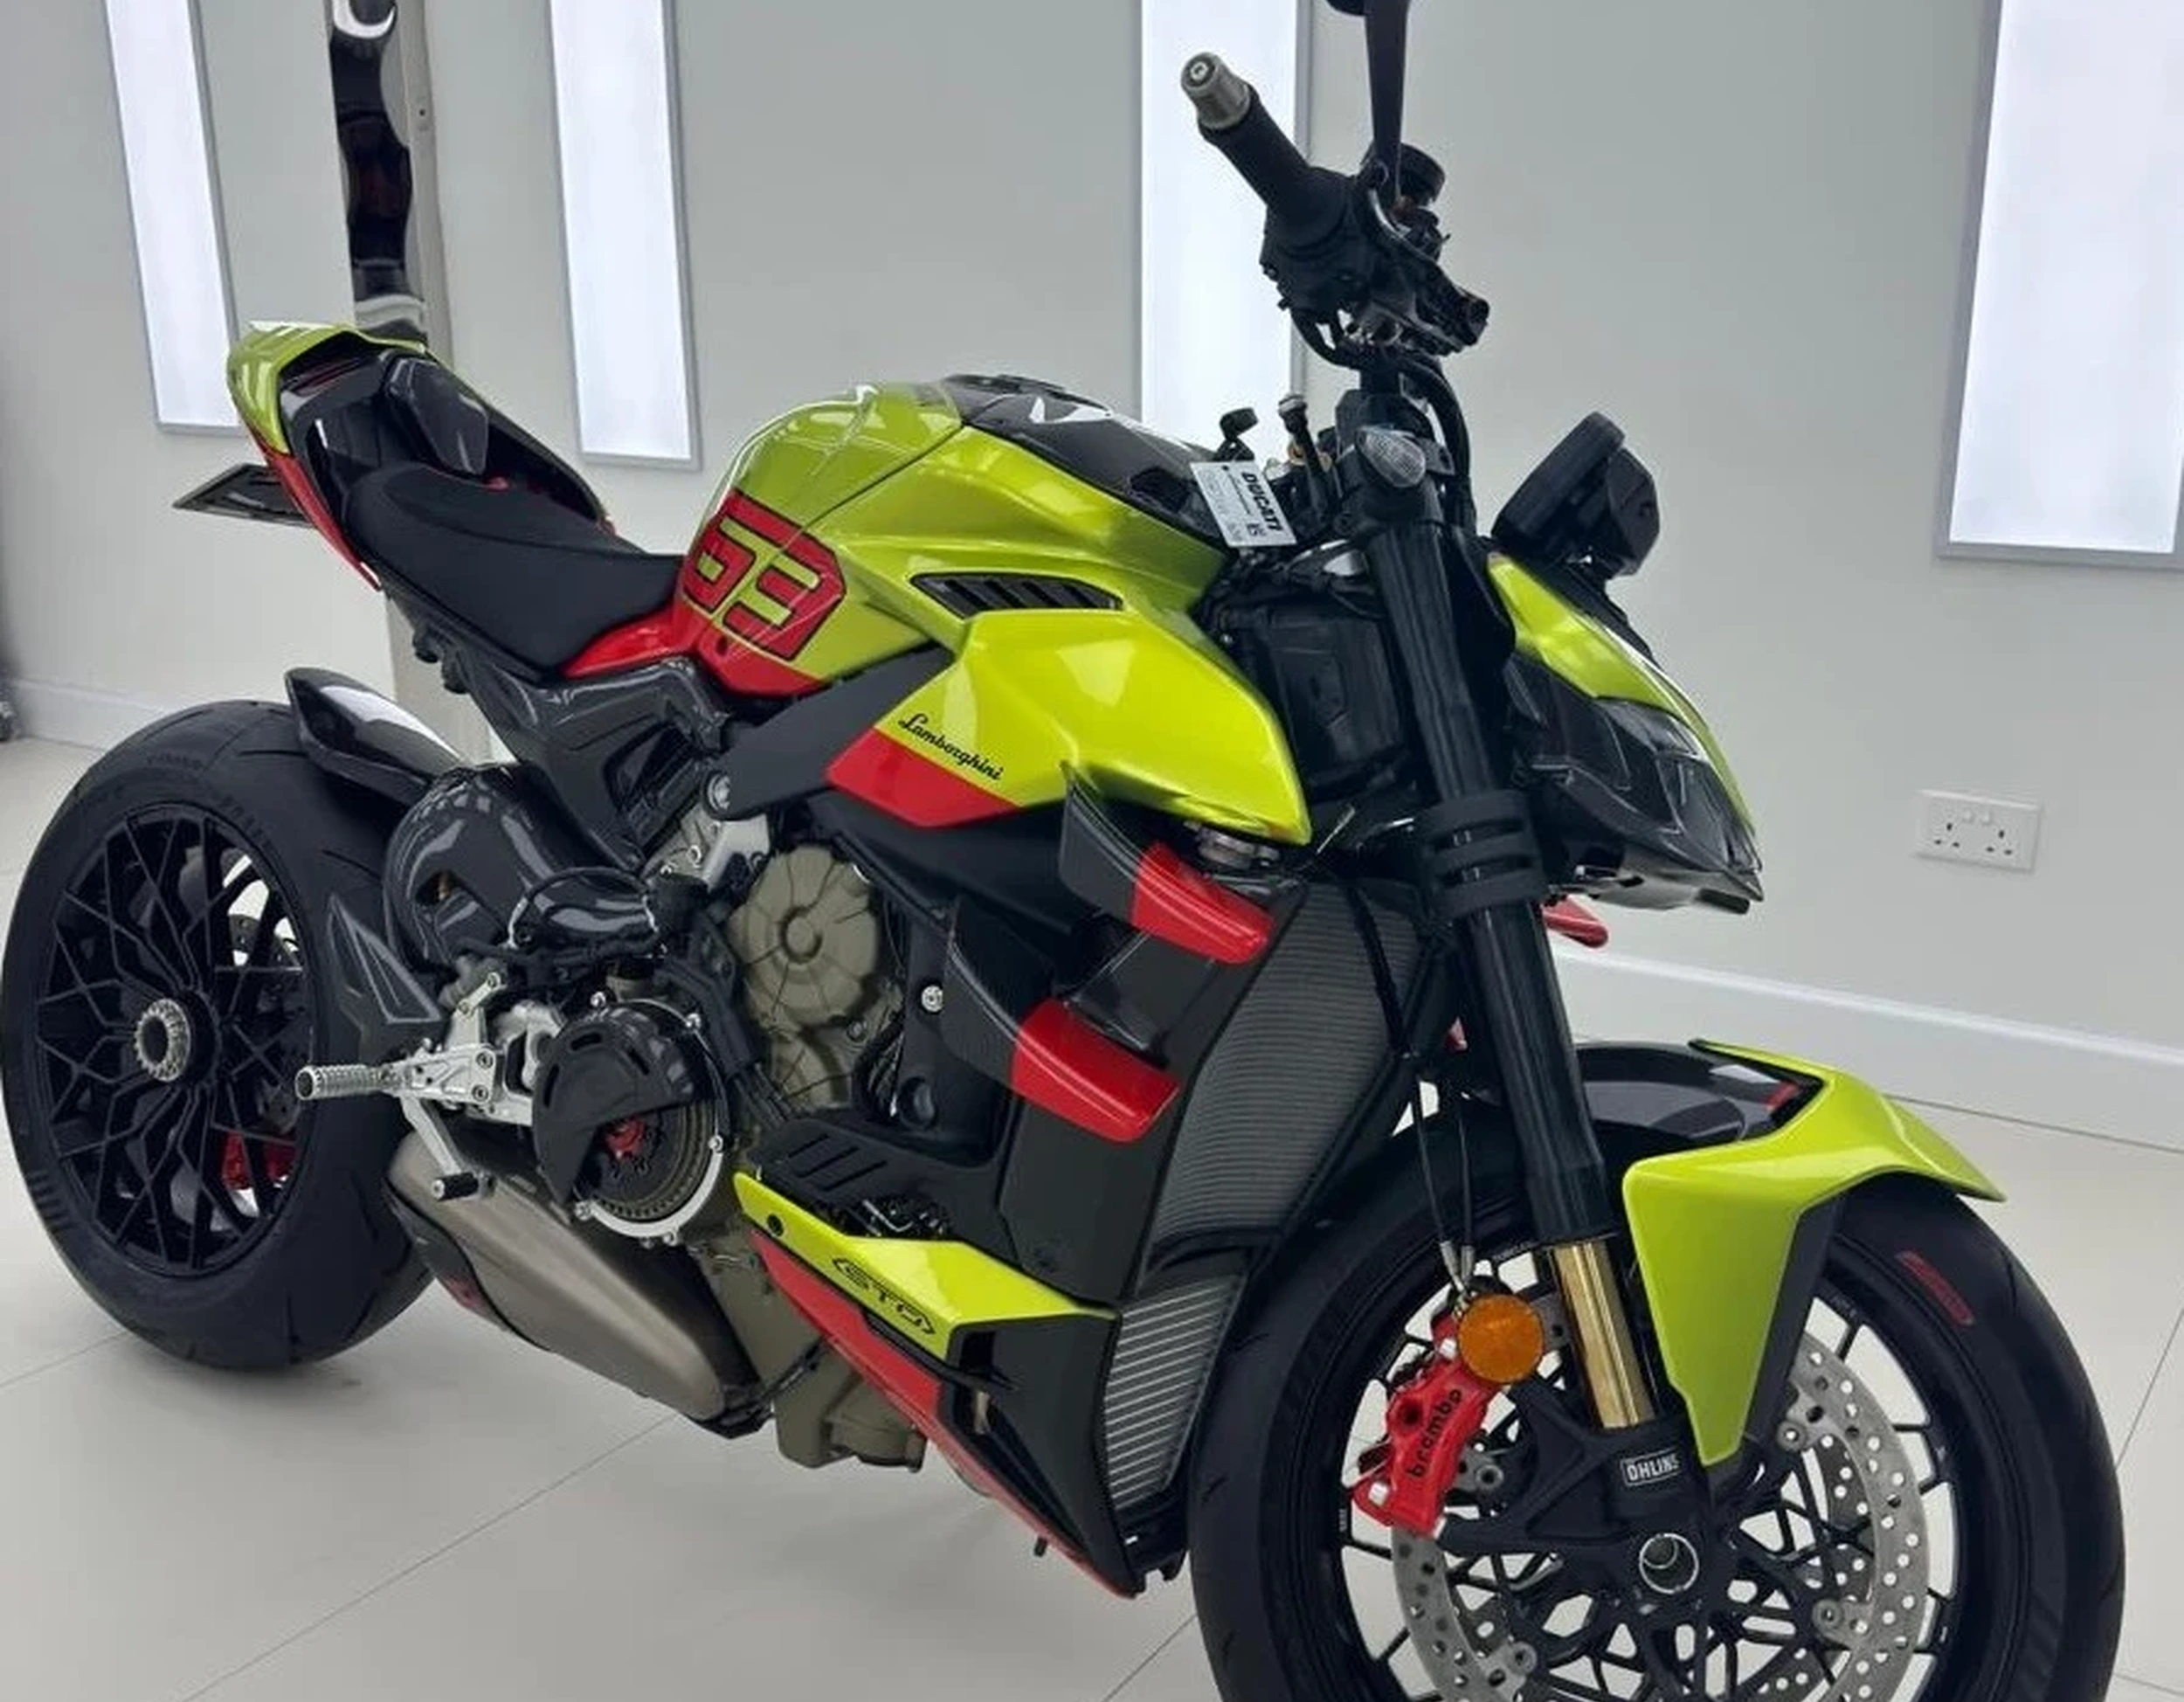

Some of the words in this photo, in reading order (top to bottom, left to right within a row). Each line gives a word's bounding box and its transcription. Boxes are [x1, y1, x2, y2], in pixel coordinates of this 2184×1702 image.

[1241, 473, 1282, 530] DUCATI
[683, 487, 847, 661] 63
[898, 713, 1004, 780] Lamborghini
[1406, 1388, 1462, 1478] brembo
